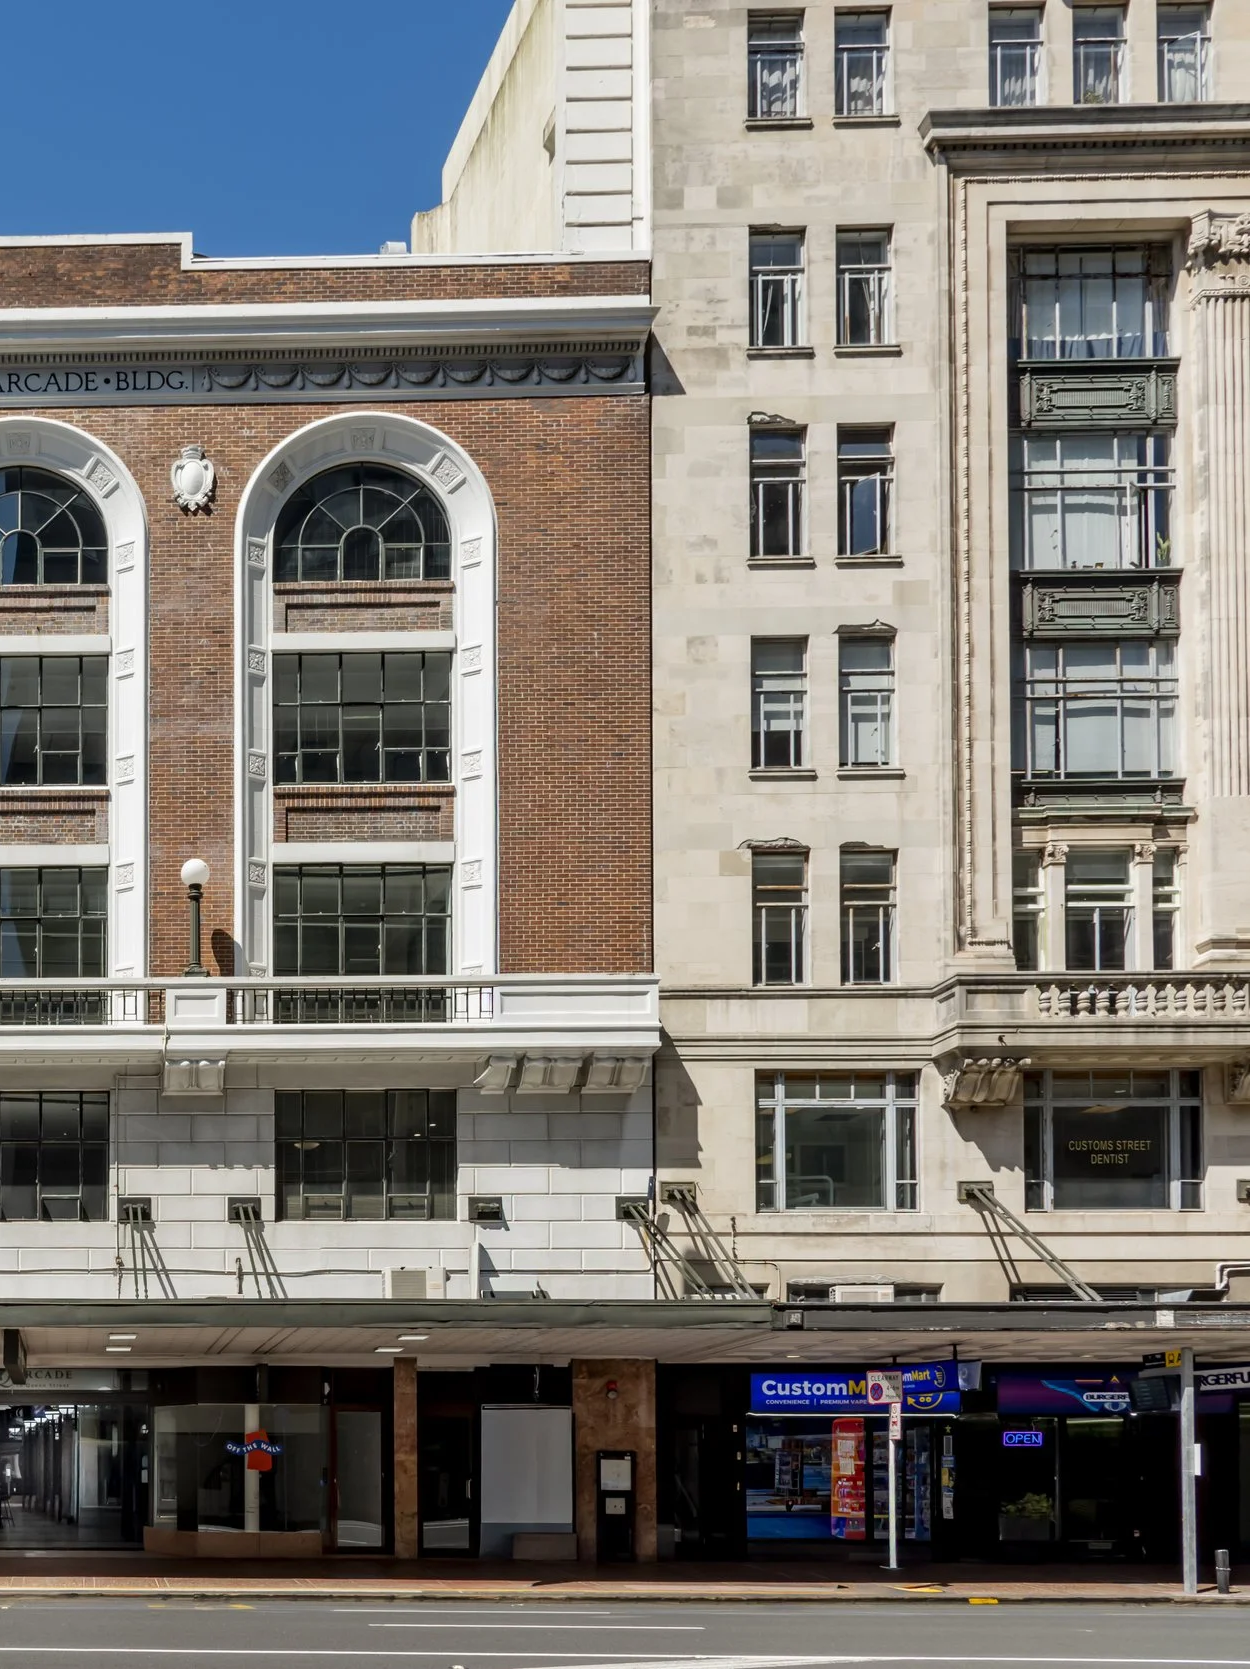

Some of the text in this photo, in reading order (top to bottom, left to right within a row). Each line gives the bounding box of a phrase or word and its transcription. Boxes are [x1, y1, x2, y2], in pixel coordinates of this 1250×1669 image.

[115, 370, 189, 391] BLDG.
[1068, 1140, 1151, 1151] CUSTOMS STREET
[1090, 1153, 1129, 1165] DENTIST
[25, 1369, 73, 1379] RCADE
[1199, 1370, 1250, 1387] RGERFU
[762, 1380, 867, 1396] CustomM
[1086, 1393, 1129, 1401] BURGERF
[1006, 1433, 1041, 1444] OPEN
[226, 1442, 281, 1454] OFF THE WALL
